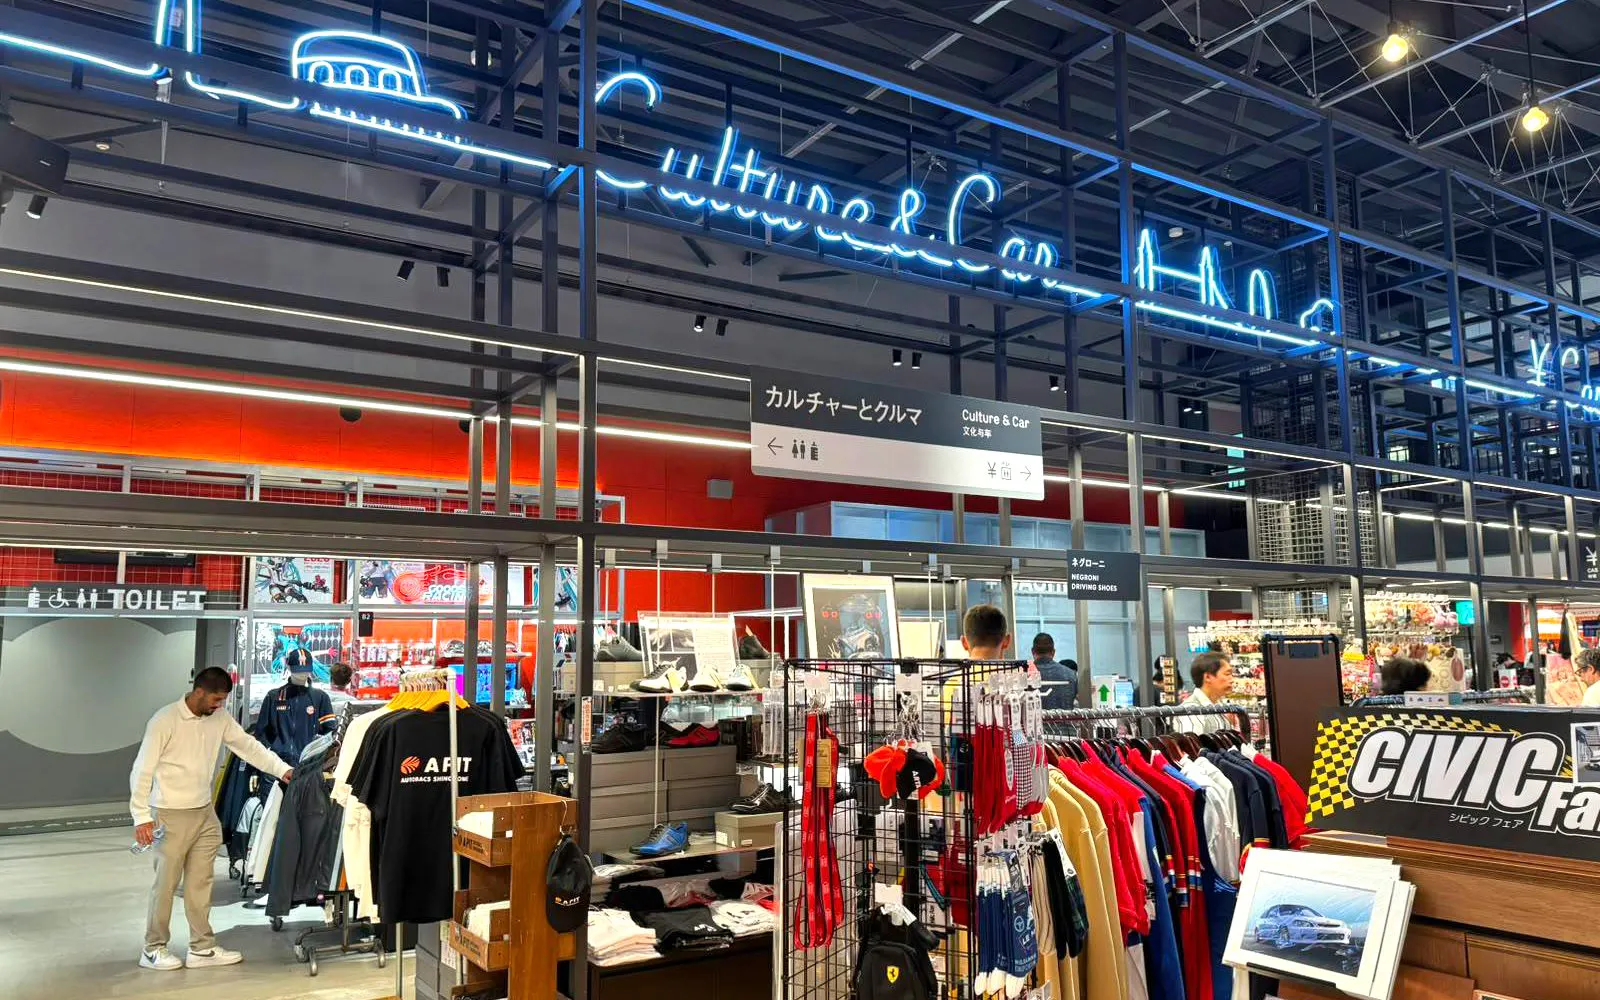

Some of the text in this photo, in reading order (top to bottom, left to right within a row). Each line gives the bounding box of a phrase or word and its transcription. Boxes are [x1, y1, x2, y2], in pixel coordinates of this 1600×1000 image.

[765, 385, 923, 426] カルチャーとクルマ
[962, 409, 1030, 428] Culture & Car
[1071, 557, 1106, 568] ネグローニ
[1071, 573, 1099, 581] NEGRONI
[1098, 584, 1118, 592] SHOES
[107, 588, 208, 611] TOILET
[1349, 729, 1562, 811] CIVIC
[1536, 780, 1600, 832] Fa
[1449, 812, 1525, 830] シビック フェア
